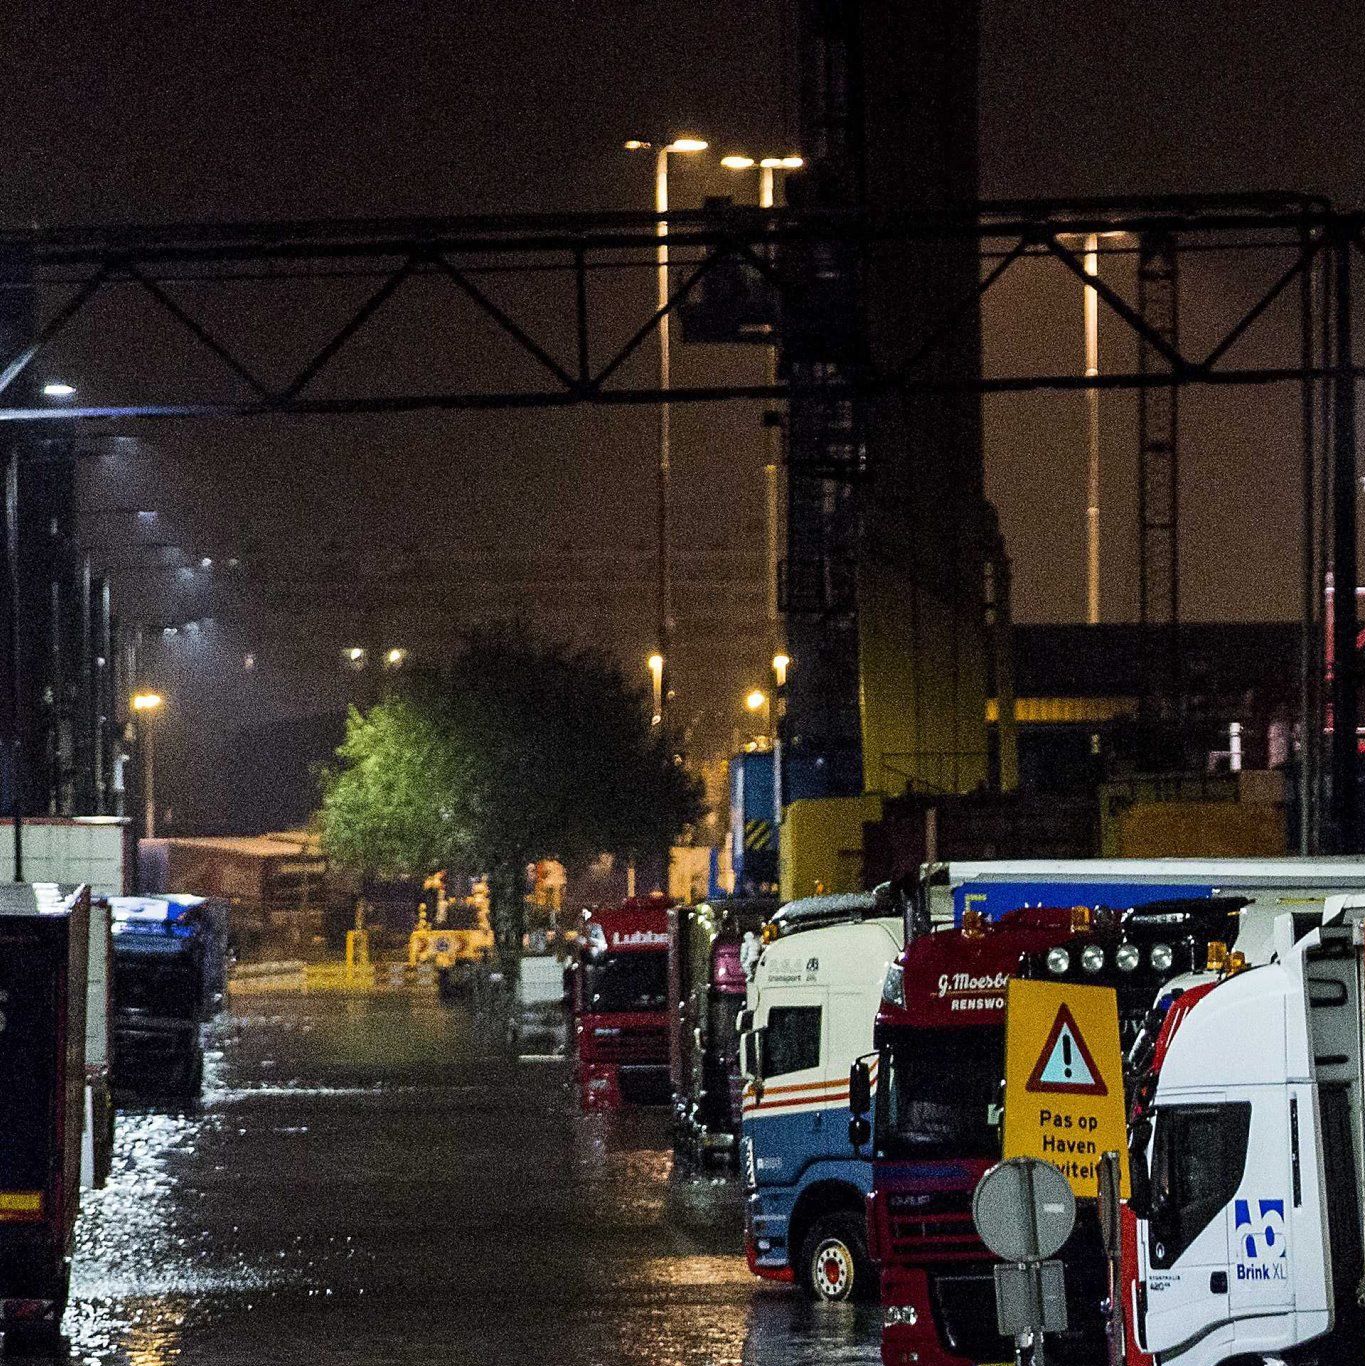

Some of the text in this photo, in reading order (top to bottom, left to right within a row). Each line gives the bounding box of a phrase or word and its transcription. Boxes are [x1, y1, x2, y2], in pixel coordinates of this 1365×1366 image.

[951, 997, 1006, 1011] RENSWO
[1040, 1109, 1098, 1132] Pas op
[1042, 1135, 1096, 1154] Haven
[1236, 1262, 1287, 1280] Brink XL
